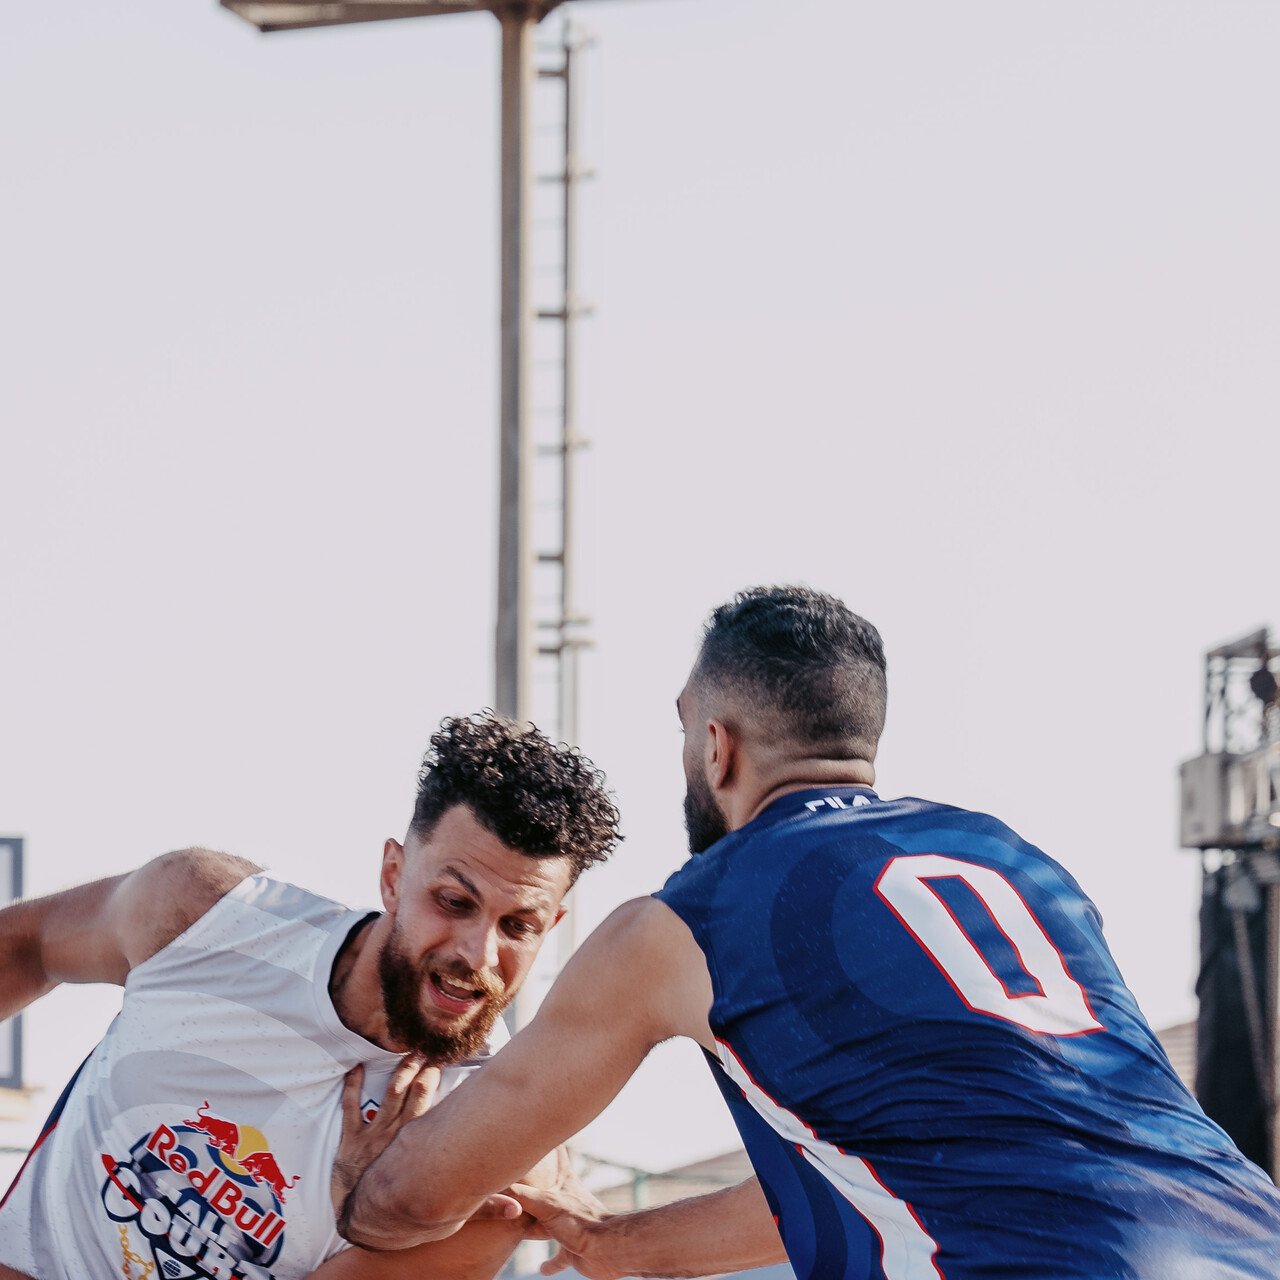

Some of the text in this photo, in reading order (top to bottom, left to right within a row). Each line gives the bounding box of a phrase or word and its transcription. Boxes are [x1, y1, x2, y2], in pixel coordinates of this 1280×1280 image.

[805, 794, 872, 812] FILA
[873, 853, 1107, 1037] 0
[146, 1124, 287, 1246] Red Bull
